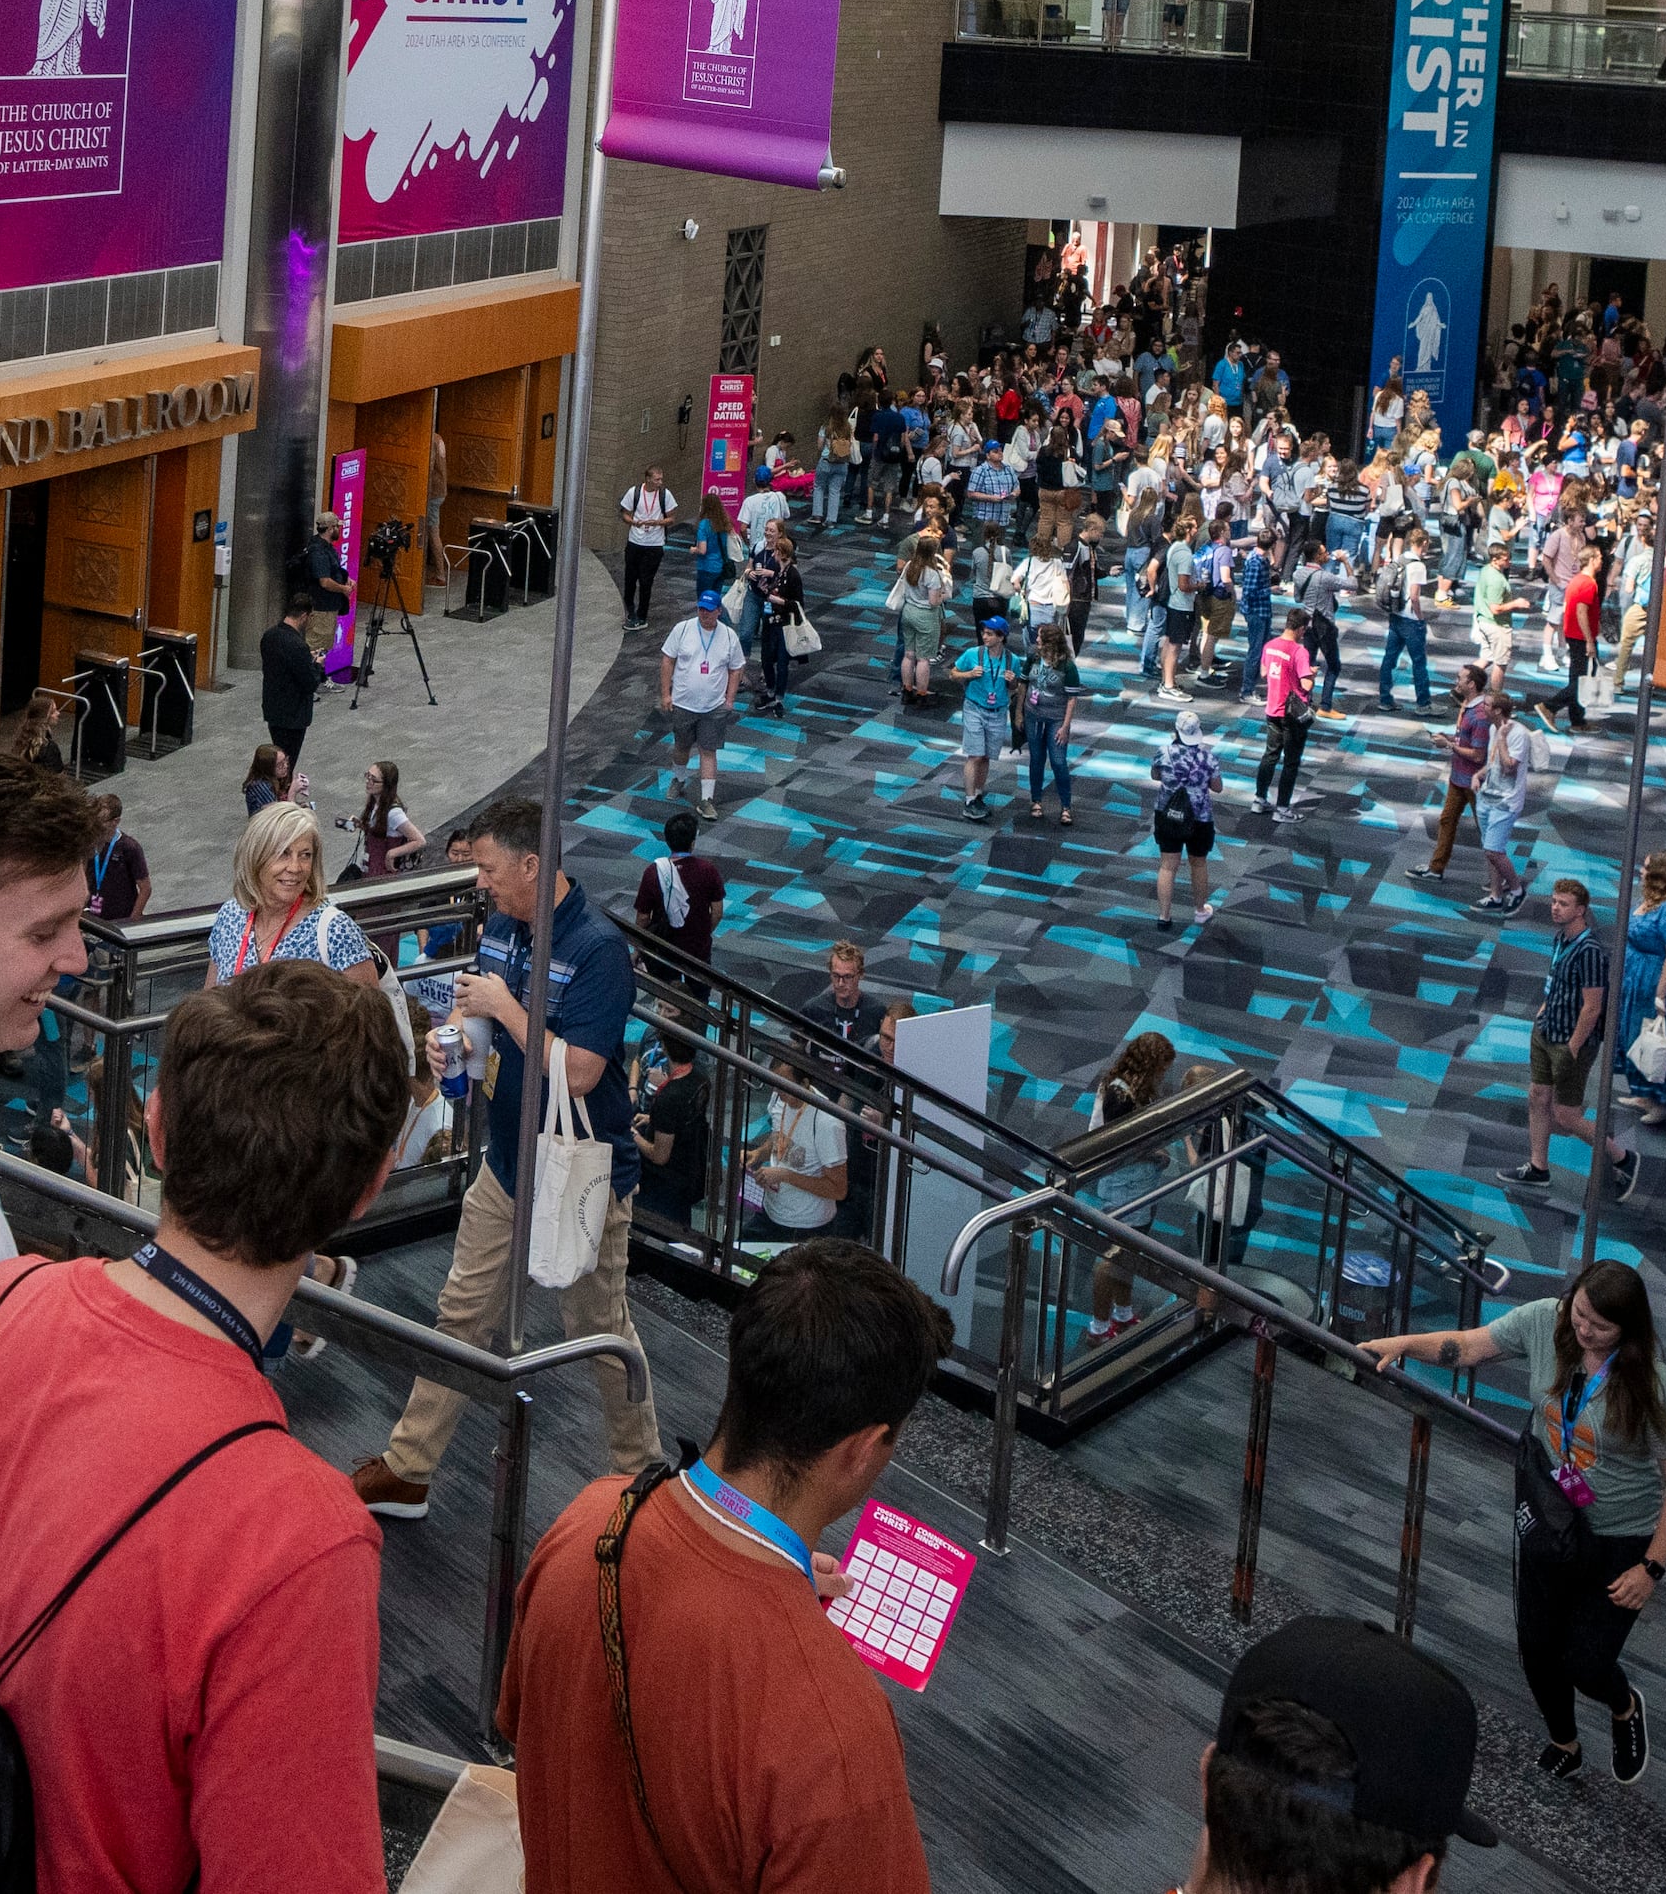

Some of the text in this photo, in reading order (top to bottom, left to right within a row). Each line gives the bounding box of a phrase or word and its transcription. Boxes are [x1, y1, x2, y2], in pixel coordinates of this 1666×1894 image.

[405, 34, 526, 47] 2024 UTAH AREA YSA CONFERENCE
[691, 71, 746, 87] JESUS CHRIST
[693, 61, 747, 75] THE CHURCH OF
[0, 102, 113, 123] THE CHURCH OF
[48, 126, 111, 153] CHRIST
[1452, 118, 1468, 148] IN
[12, 157, 73, 174] LATTER-DAY
[75, 155, 108, 170] SAINTS
[57, 372, 256, 453] BALLROOM
[714, 411, 745, 420] DATING
[717, 402, 743, 411] SPEED
[341, 491, 353, 539] SPEED
[171, 1271, 222, 1313] CONFERENCE
[714, 1490, 752, 1520] CHRIST
[873, 1511, 911, 1534] CHRIST
[914, 1532, 940, 1550] BINGO
[916, 1527, 966, 1561] CONNECTION
